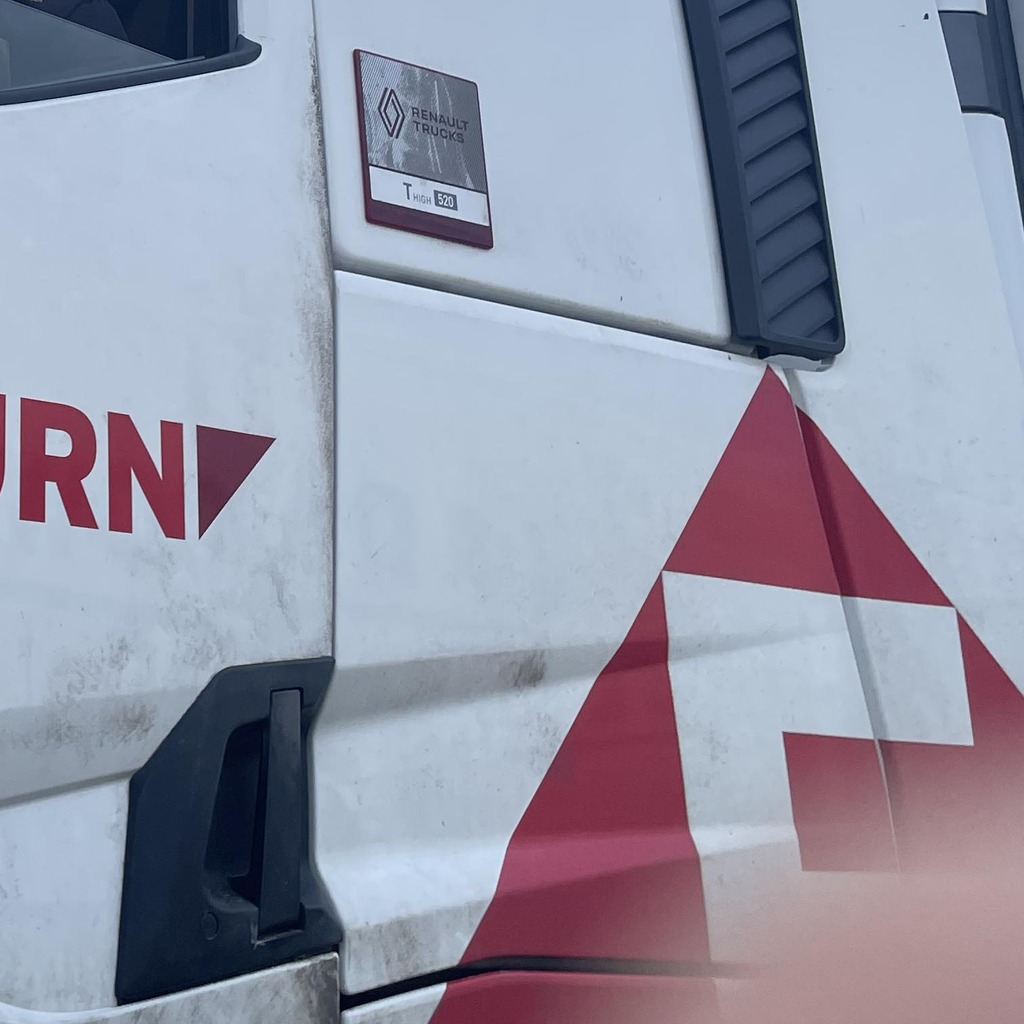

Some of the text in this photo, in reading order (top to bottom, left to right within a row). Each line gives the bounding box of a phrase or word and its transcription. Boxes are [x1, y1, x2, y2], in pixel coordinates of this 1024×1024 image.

[412, 107, 469, 132] RENAULT
[414, 122, 465, 143] TRUCKS
[413, 194, 432, 205] HIGH
[437, 193, 454, 208] 520
